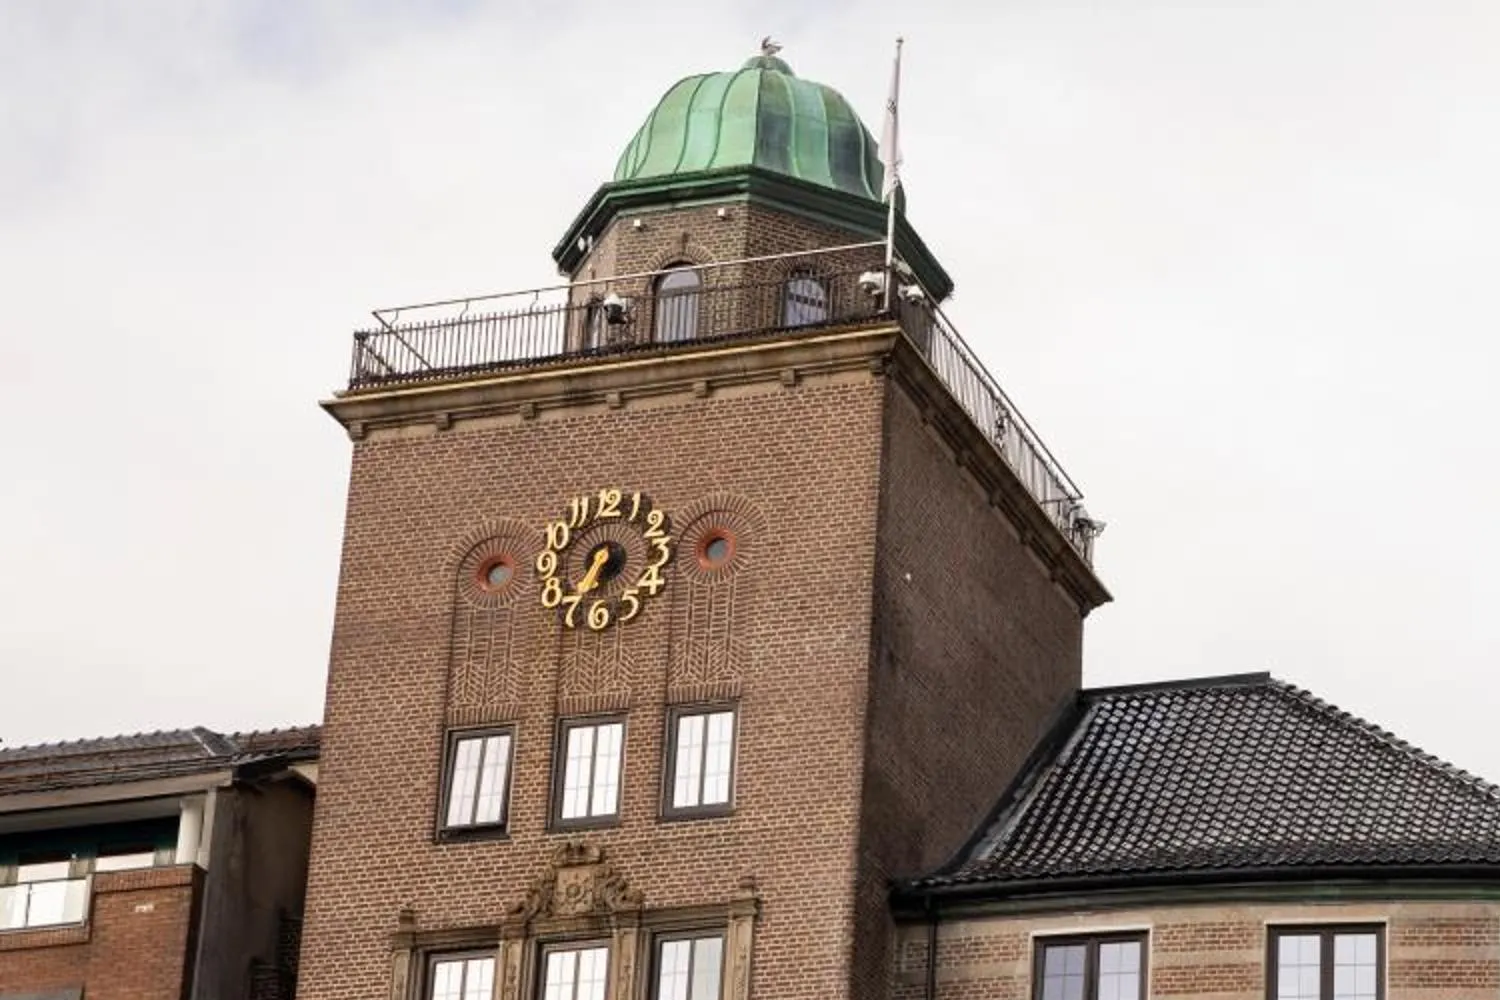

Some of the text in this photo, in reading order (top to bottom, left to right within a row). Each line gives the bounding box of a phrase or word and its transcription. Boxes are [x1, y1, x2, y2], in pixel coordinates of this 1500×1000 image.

[569, 497, 589, 528] 11
[594, 489, 621, 520] 12
[629, 491, 641, 521] 1
[546, 521, 569, 550] 10
[644, 509, 665, 537] 2
[536, 551, 557, 579] 9
[651, 536, 671, 567] 3
[541, 577, 562, 608] 8
[637, 565, 665, 595] 4
[561, 594, 583, 628] 7
[587, 599, 609, 630] 6
[619, 589, 639, 621] 5
